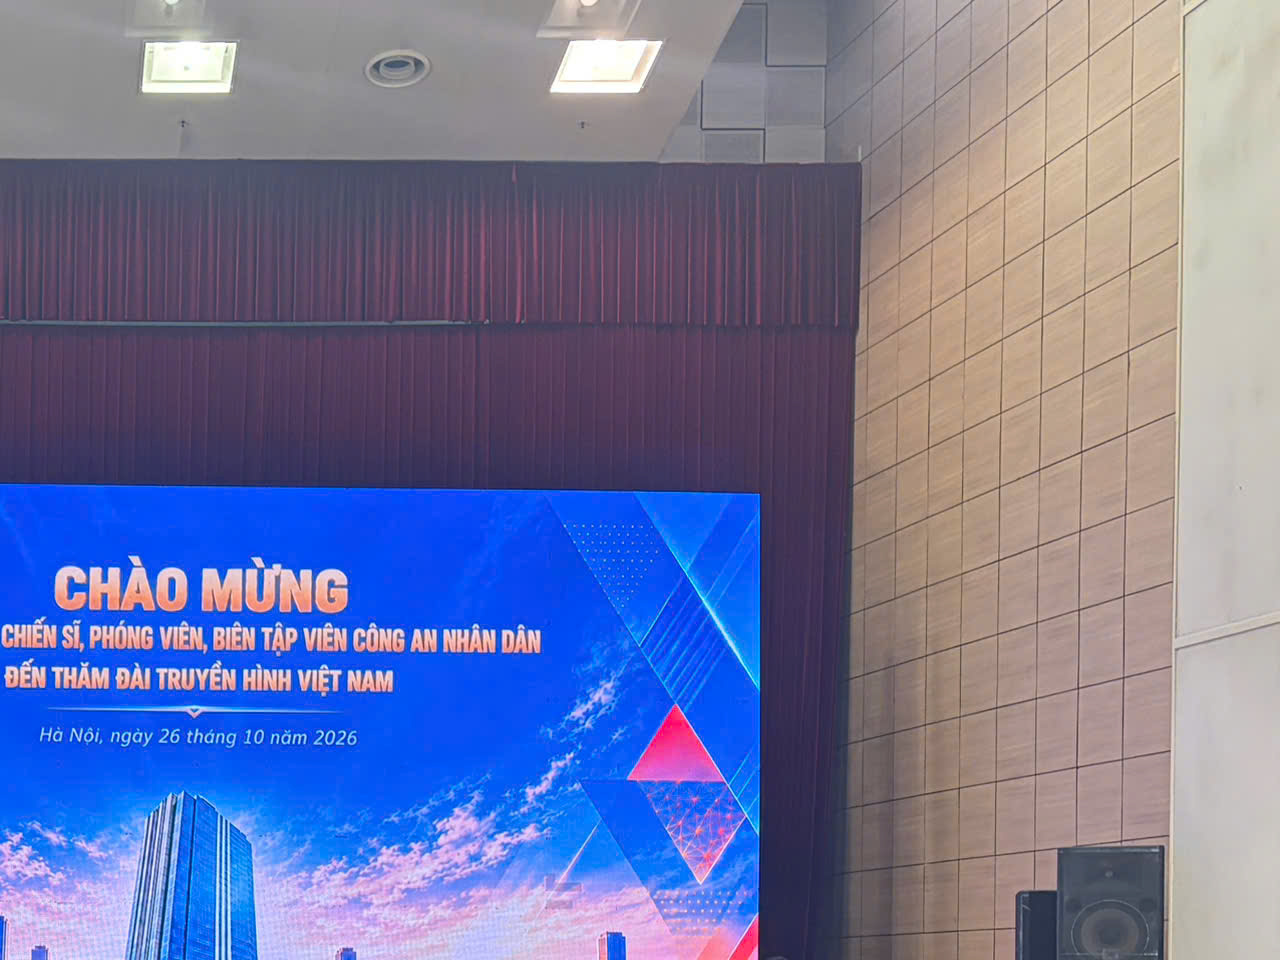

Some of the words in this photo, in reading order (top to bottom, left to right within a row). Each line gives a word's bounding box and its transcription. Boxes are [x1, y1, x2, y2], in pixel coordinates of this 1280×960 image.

[54, 555, 188, 612] CHÀO
[201, 557, 349, 614] MỪNG
[1, 617, 57, 649] CHIẾN
[61, 620, 84, 653] SĨ,
[90, 620, 154, 650] PHÓNG
[160, 620, 208, 654] VIÊN,
[213, 621, 256, 651] BIÊN
[261, 621, 298, 656] TẬP
[303, 622, 347, 652] VIÊN
[353, 622, 406, 653] CÔNG
[410, 628, 438, 653] AN
[443, 623, 497, 654] NHÂN
[501, 624, 542, 654] DÂN
[3, 658, 47, 689] ĐẾN
[52, 662, 110, 690] THĂM
[116, 663, 151, 690] ĐÀI
[156, 660, 237, 691] TRUYỀN
[242, 663, 292, 692] HÌNH
[297, 664, 342, 697] VIỆT
[347, 669, 394, 693] NAM
[39, 727, 63, 743] Hà
[70, 727, 103, 745] Nội,
[110, 728, 154, 748] ngày
[159, 729, 181, 744] 26
[186, 728, 237, 748] tháng
[243, 730, 265, 745] 10
[271, 729, 308, 745] năm
[313, 730, 358, 746] 2026
